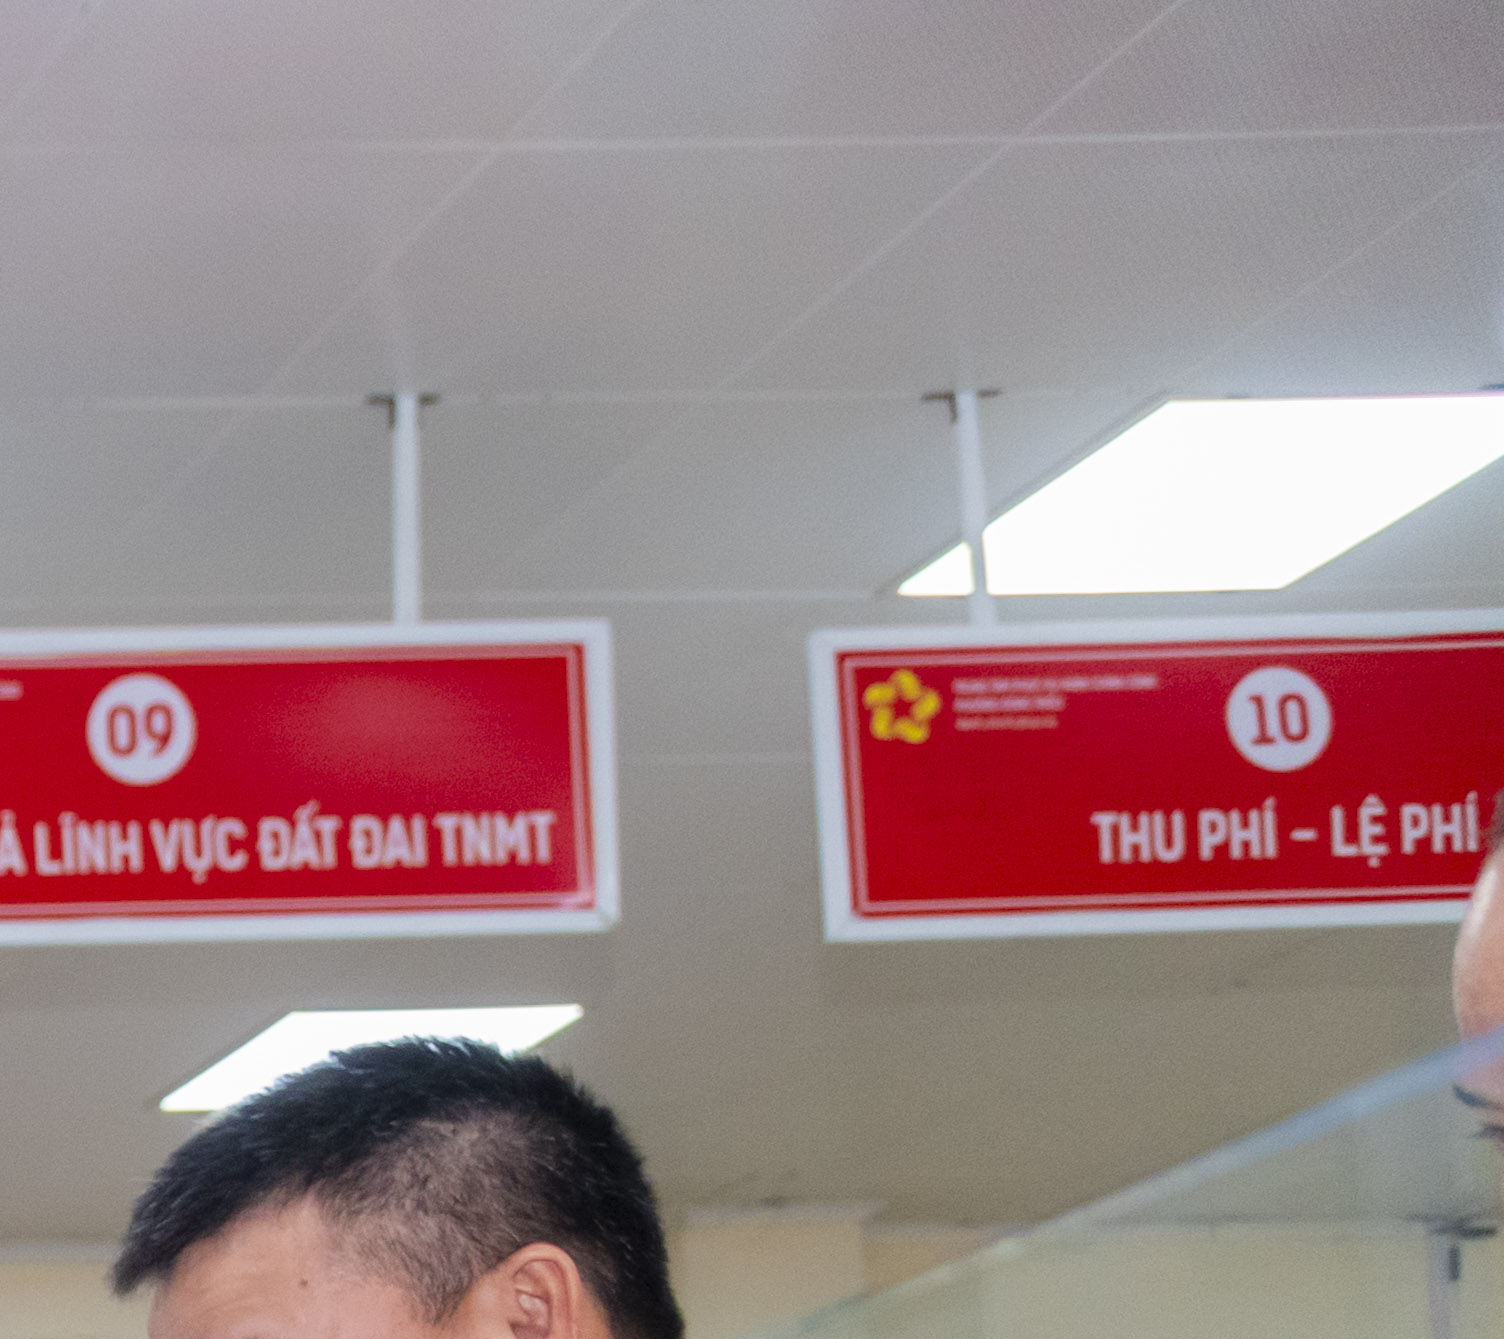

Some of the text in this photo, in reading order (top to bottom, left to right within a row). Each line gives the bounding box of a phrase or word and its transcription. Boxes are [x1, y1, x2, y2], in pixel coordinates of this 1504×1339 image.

[105, 702, 175, 760] 09
[1249, 694, 1312, 746] 10
[34, 816, 144, 879] LĨNH
[150, 813, 248, 885] VỰC
[256, 800, 342, 872] ĐẤT
[349, 812, 426, 870] ĐAI
[434, 810, 557, 871] TNMT
[1090, 809, 1187, 864] THU
[1198, 796, 1279, 861] PHÍ
[1330, 793, 1387, 868] LỆ
[1400, 790, 1480, 855] PHÍ
